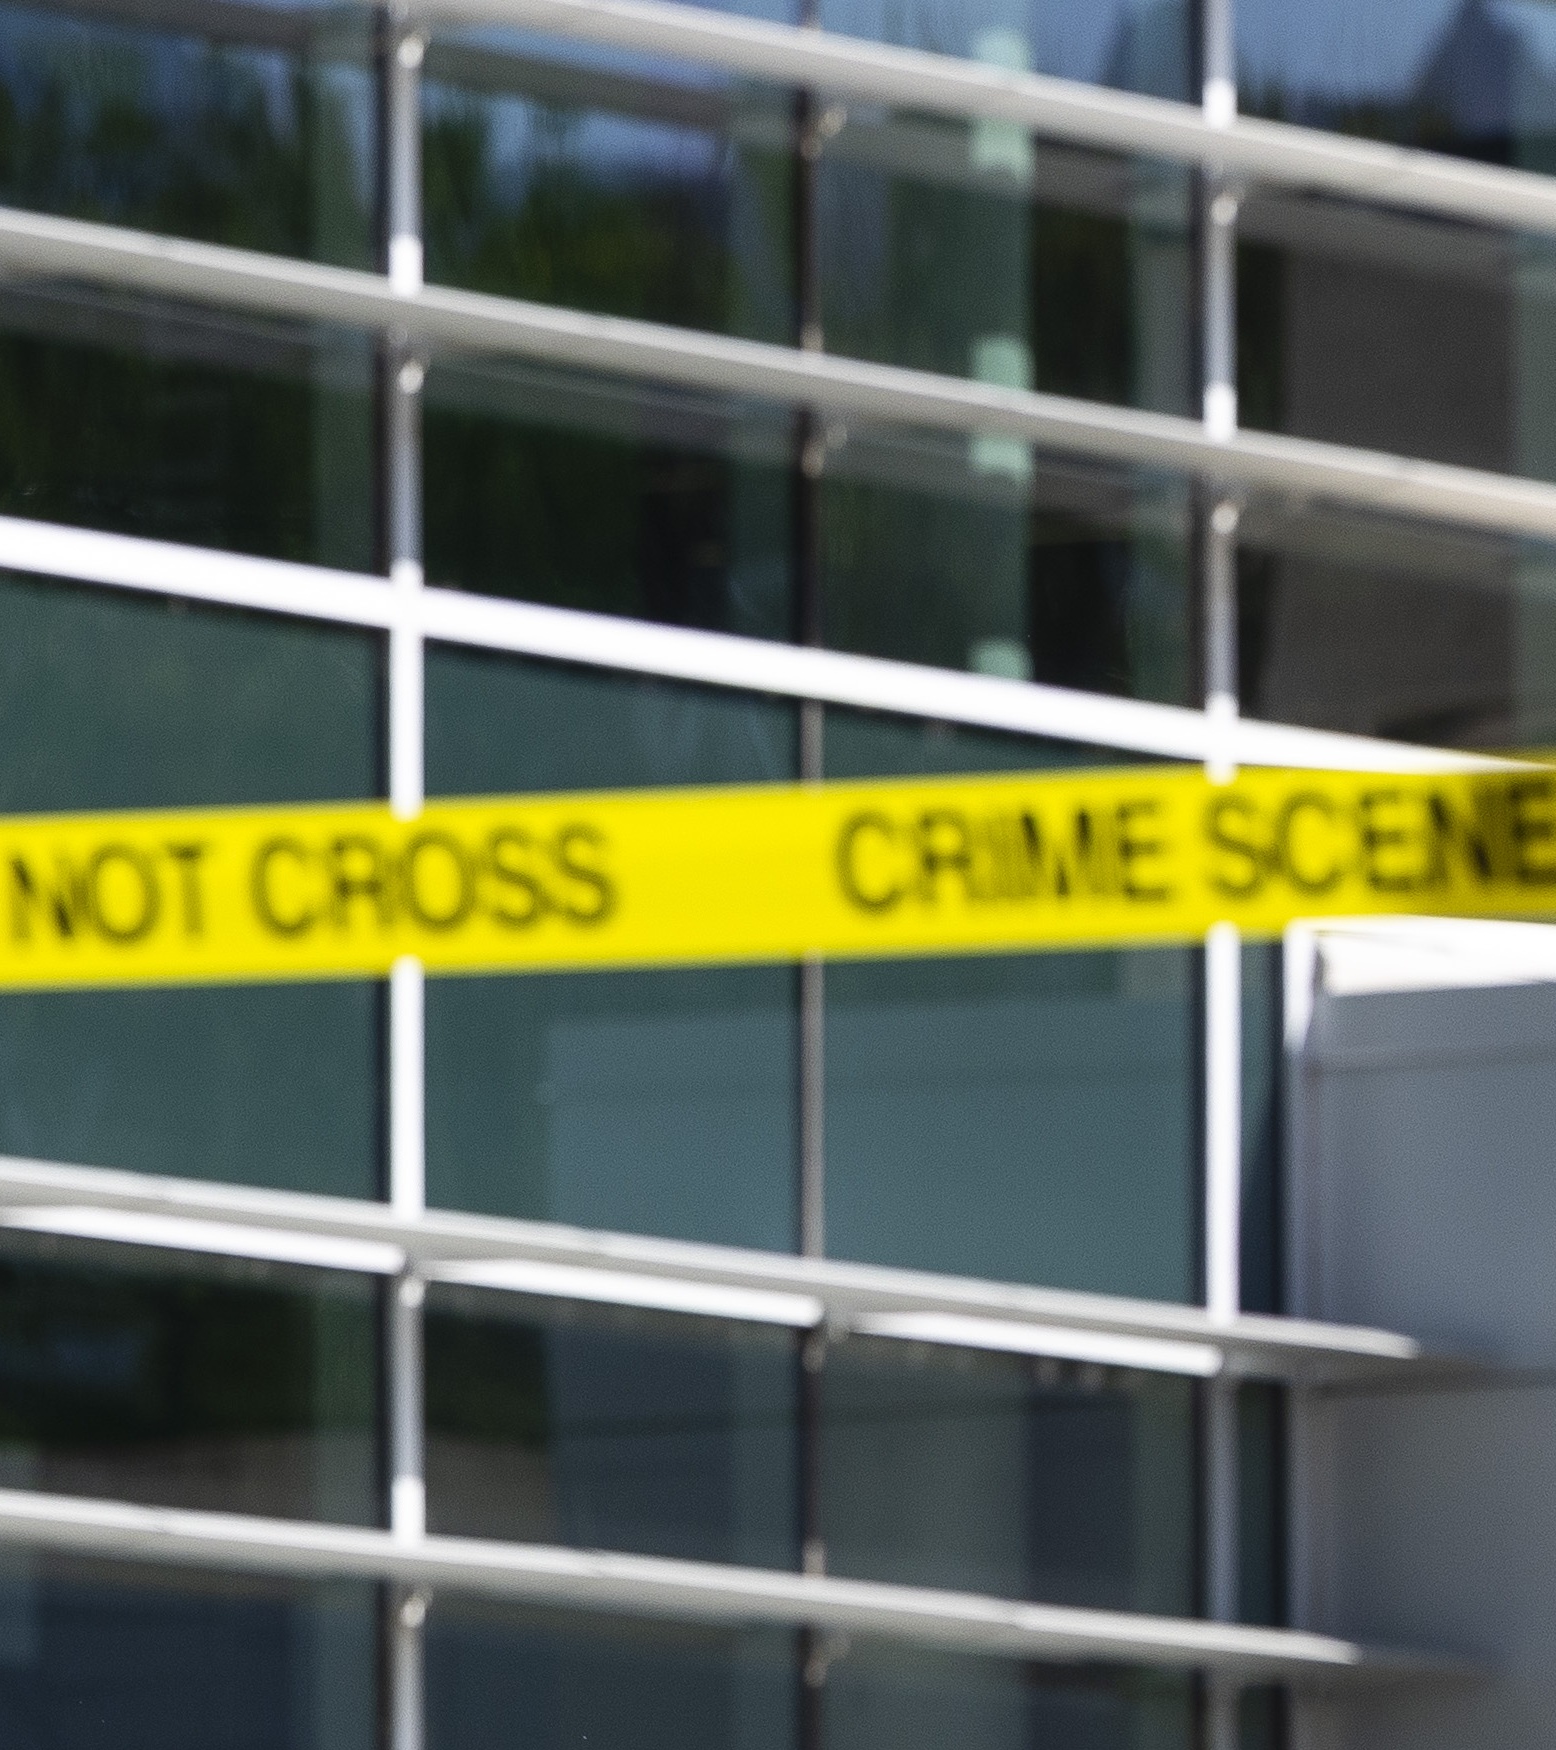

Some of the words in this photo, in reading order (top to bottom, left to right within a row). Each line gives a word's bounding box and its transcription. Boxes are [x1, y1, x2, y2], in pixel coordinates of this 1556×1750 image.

[11, 841, 213, 944] NOT
[249, 823, 617, 938] CROSS
[838, 802, 1167, 912] CRIME
